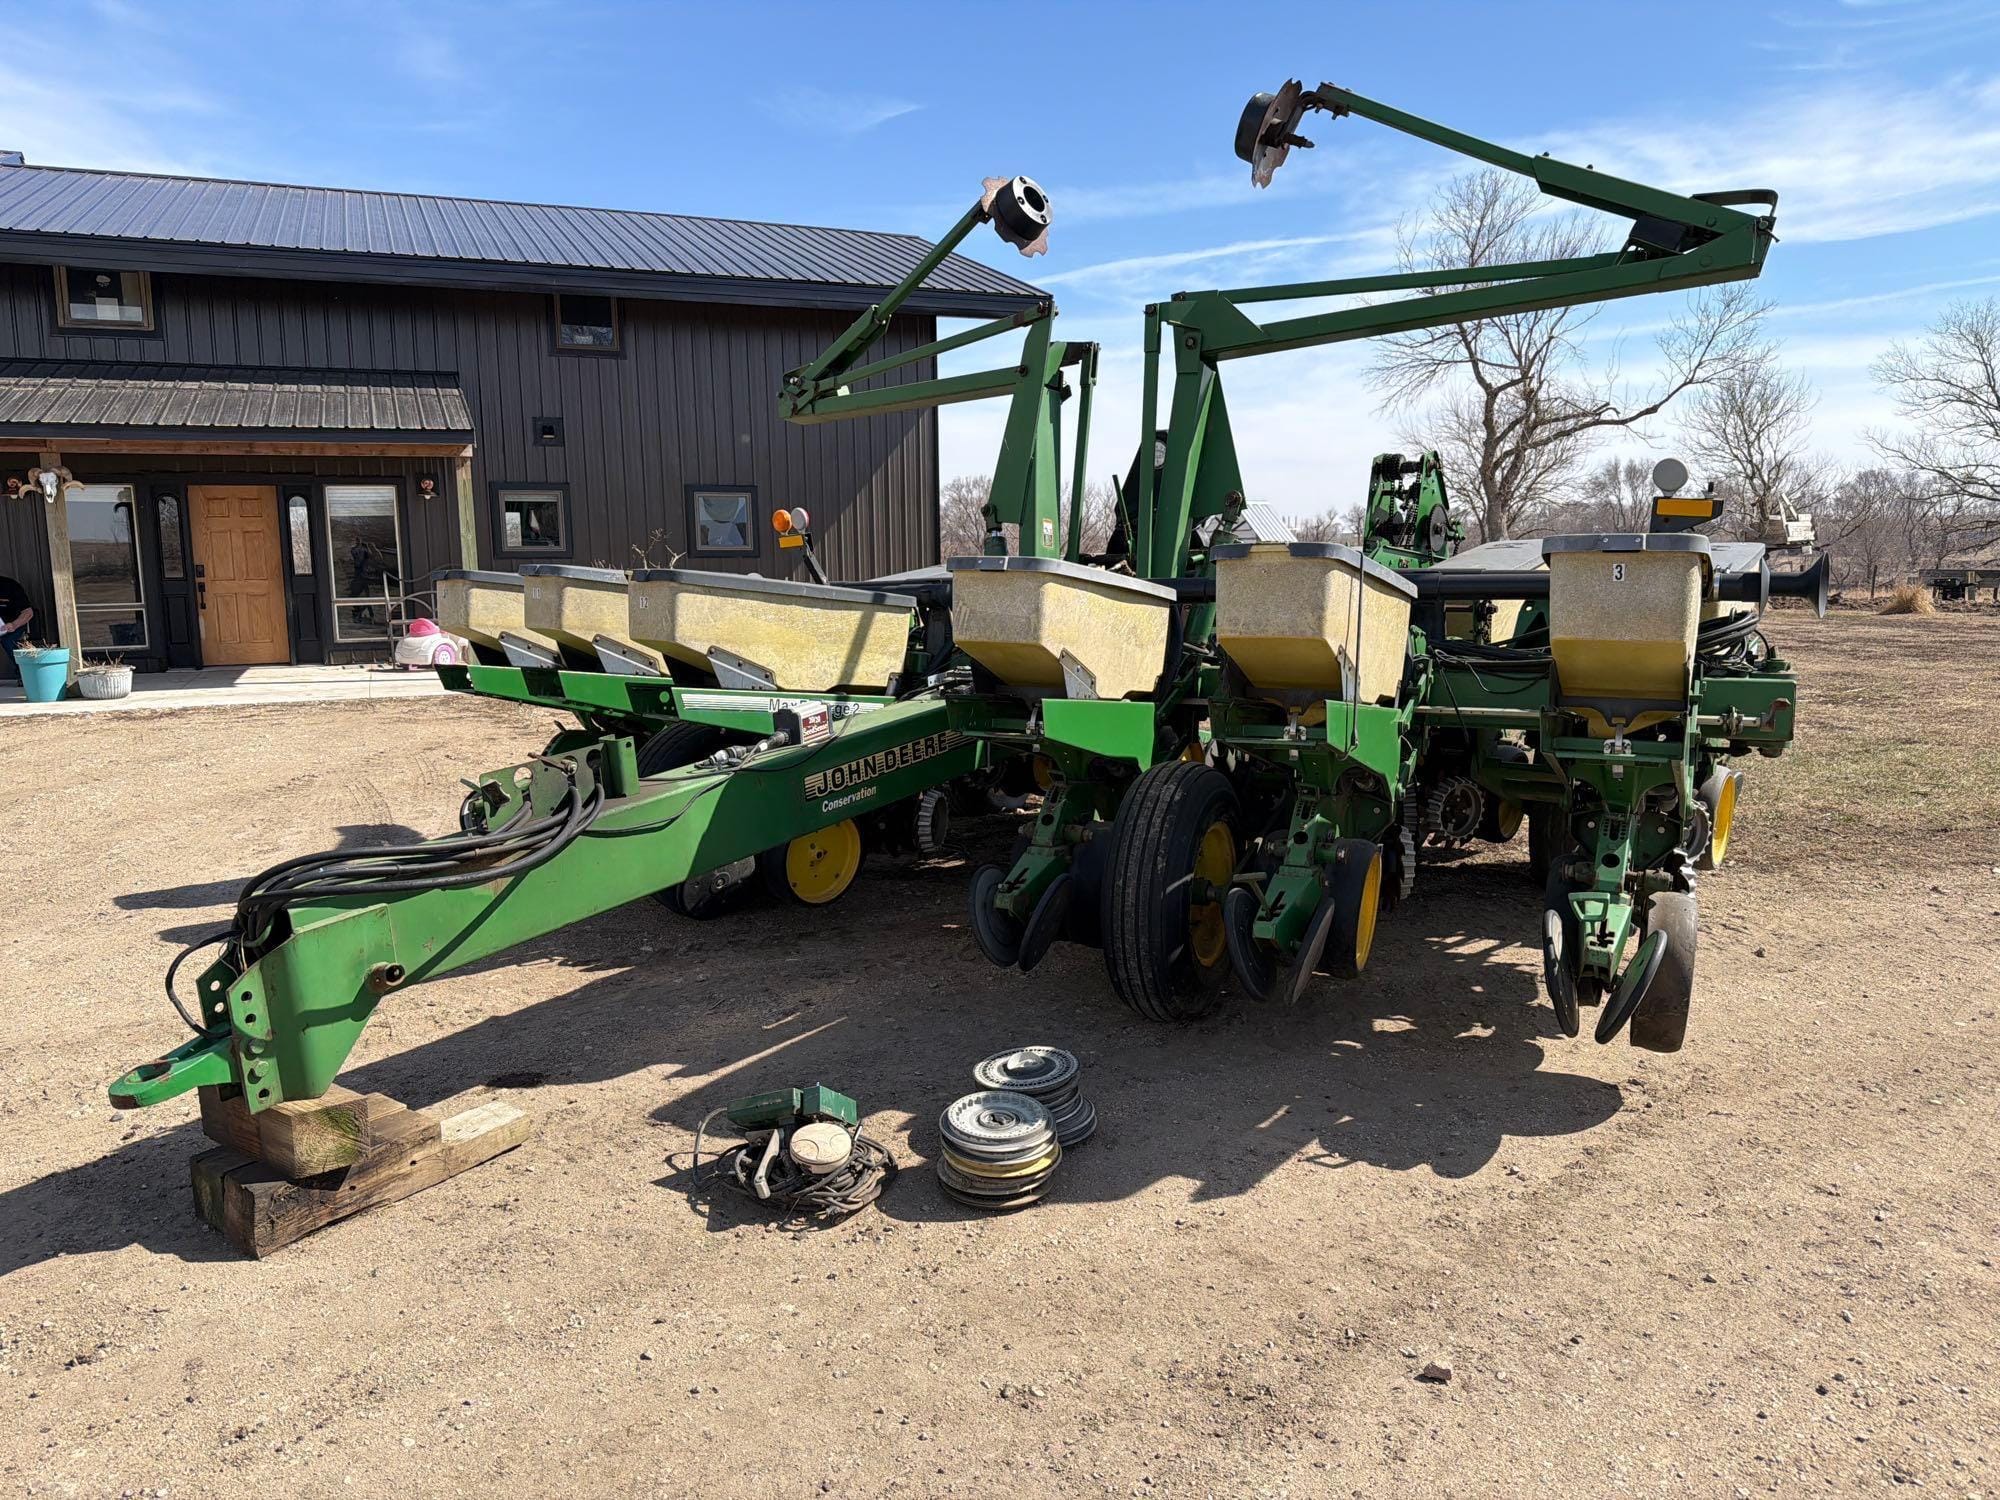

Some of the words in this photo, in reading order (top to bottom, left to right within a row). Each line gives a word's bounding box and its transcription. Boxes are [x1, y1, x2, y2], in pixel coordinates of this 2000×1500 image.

[1615, 564, 1623, 581] 3
[640, 596, 649, 609] 12
[815, 755, 878, 796] JOHN
[883, 732, 950, 772] DEERE
[822, 785, 877, 813] Conservation
